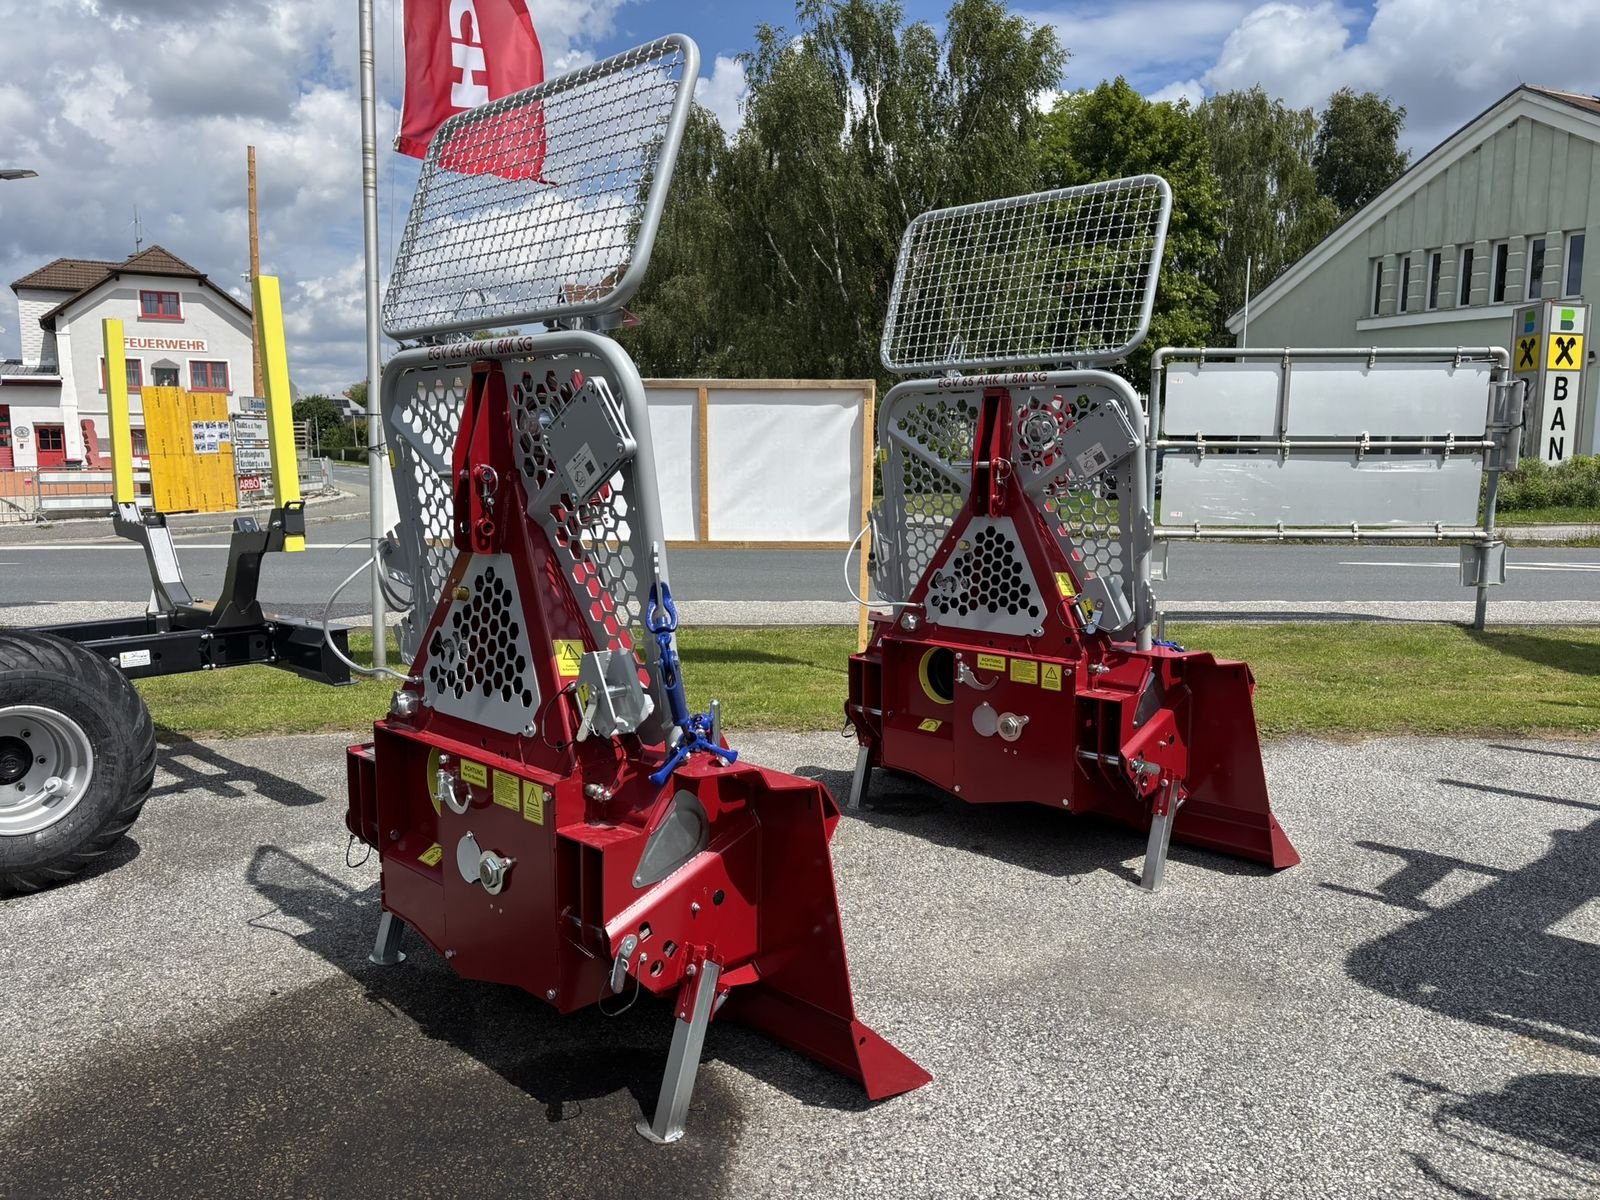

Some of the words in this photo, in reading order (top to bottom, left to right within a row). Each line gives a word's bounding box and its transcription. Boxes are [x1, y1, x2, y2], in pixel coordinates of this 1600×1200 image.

[123, 337, 205, 350] FEUERWEHR
[428, 345, 448, 361] EGV
[450, 343, 462, 359] 65
[464, 341, 487, 357] AHK
[490, 338, 515, 355] 1.8M
[517, 336, 533, 352] SG
[938, 377, 959, 389] EGV
[961, 376, 974, 387] 65
[977, 375, 1000, 387] AHK
[1003, 373, 1029, 385] 1.8M
[1031, 372, 1048, 382] SG
[1548, 376, 1568, 470] BAN
[464, 764, 484, 776] ACHTUNG
